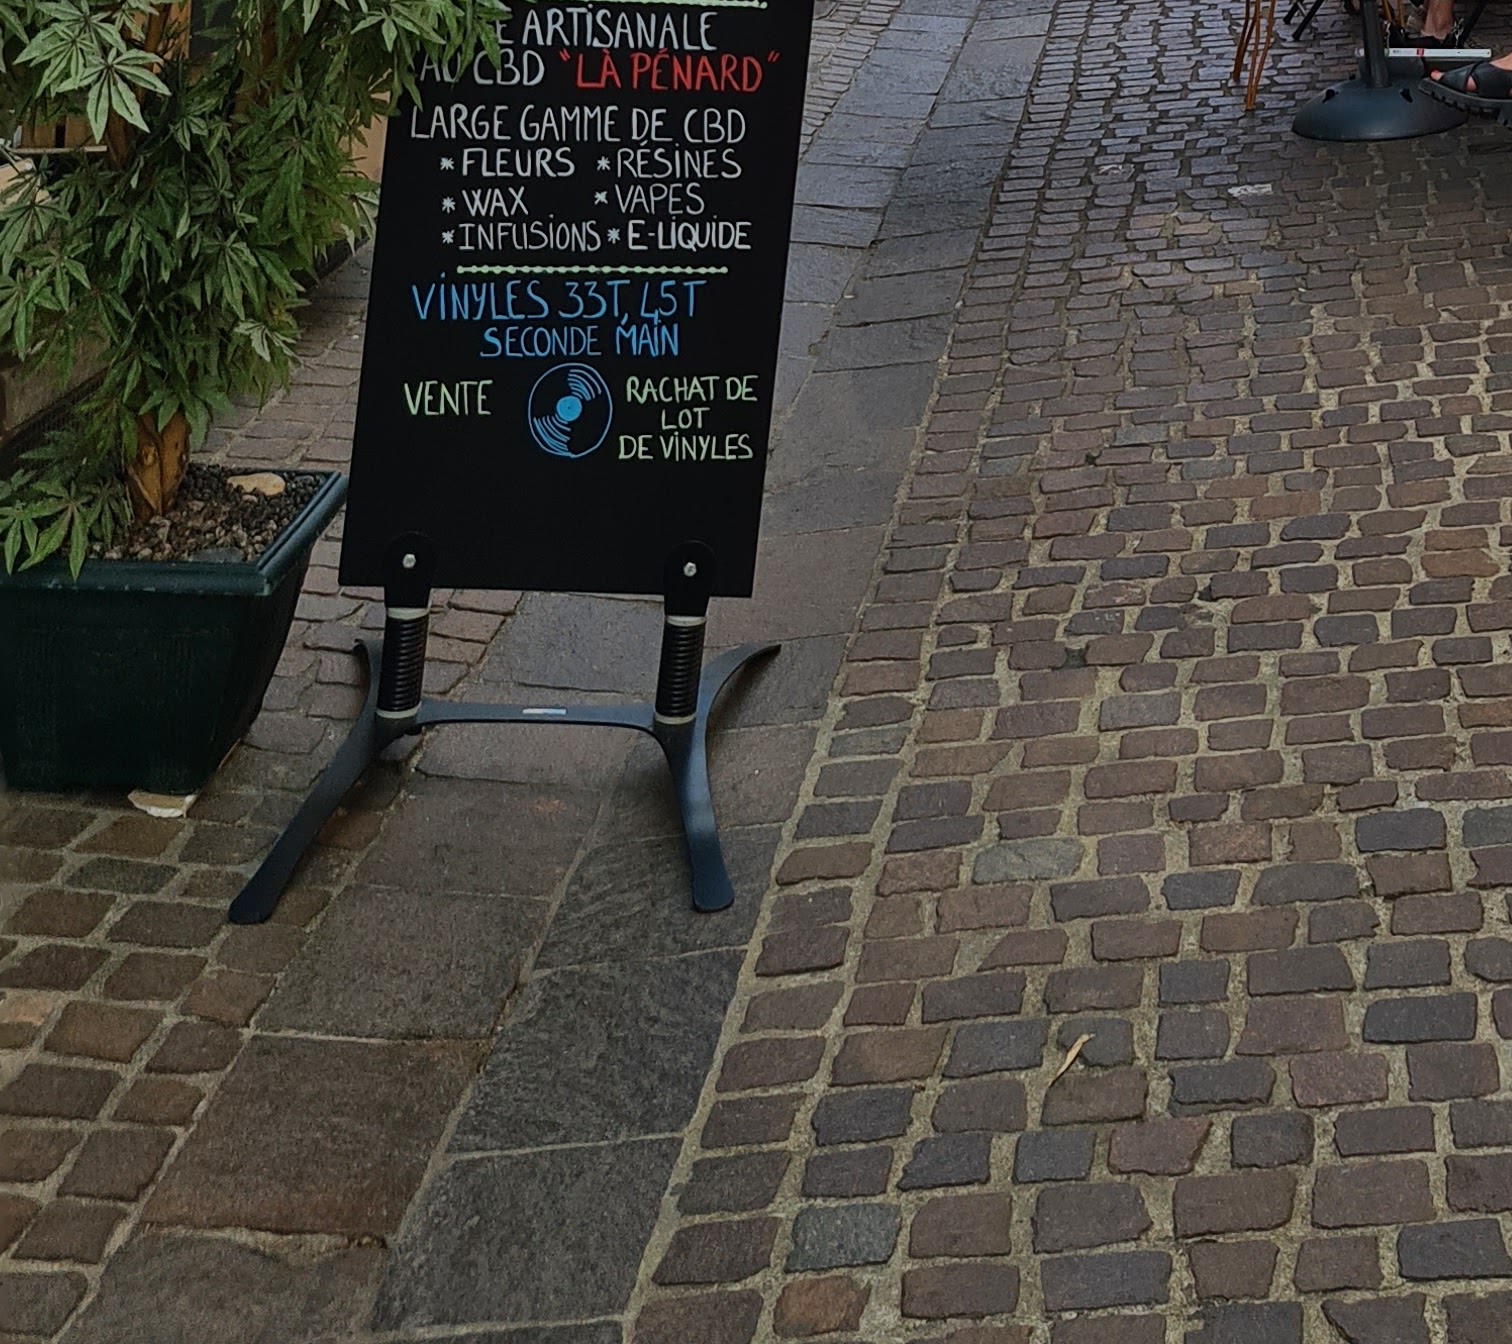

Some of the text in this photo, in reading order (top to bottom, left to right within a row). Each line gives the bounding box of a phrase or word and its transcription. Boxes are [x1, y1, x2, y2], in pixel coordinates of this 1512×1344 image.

[521, 3, 718, 52] ARTISANALE
[472, 49, 545, 87] CBD
[410, 104, 746, 144] LARGE GAMME DE CBD
[462, 147, 576, 178] FLEURS
[462, 183, 706, 217] WAX VAPES
[458, 214, 752, 252] INFUSIONS E-LIQUIDE
[412, 272, 548, 321] VINYLES
[640, 279, 707, 323] 45T
[480, 319, 679, 358] SECONDE MAIN
[403, 379, 493, 417] VENTE
[626, 375, 758, 404] RACHAT DE
[661, 407, 710, 431] LOT
[618, 430, 753, 462] DE VINYLES
